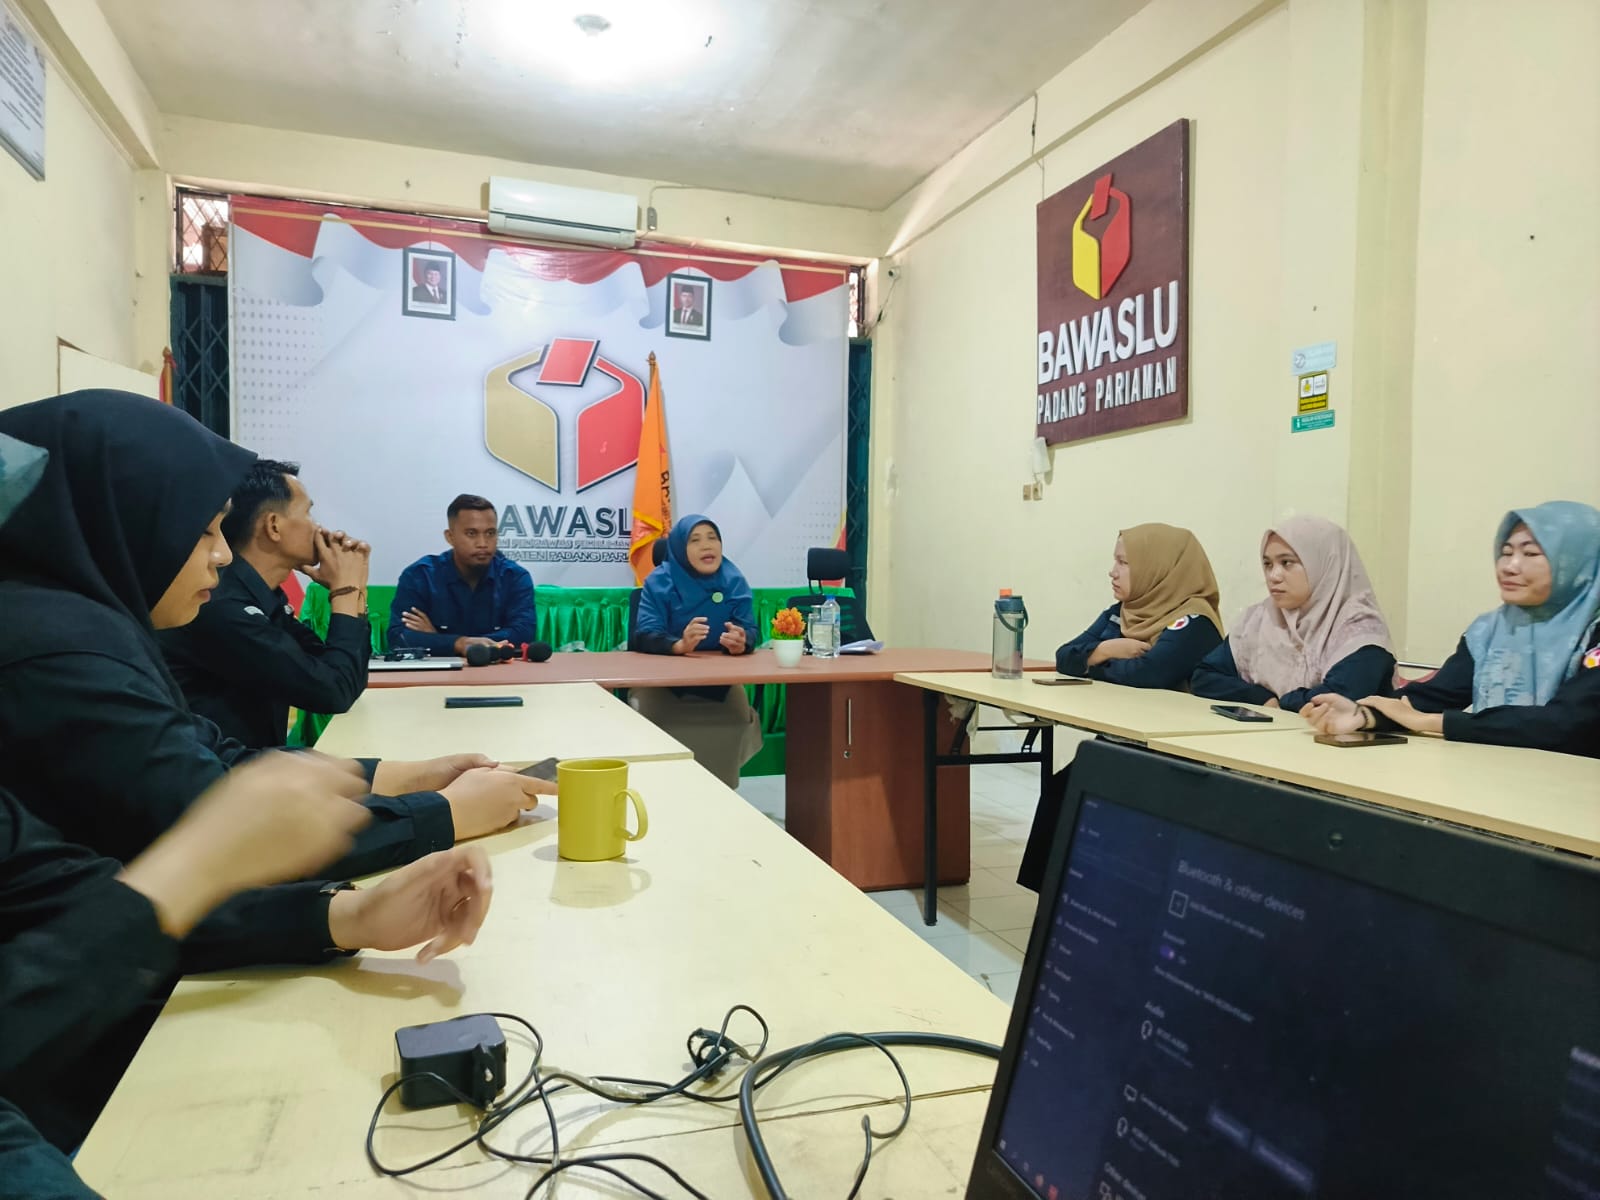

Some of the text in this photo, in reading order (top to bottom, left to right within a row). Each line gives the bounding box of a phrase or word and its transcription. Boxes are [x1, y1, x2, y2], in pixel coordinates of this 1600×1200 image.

[1037, 280, 1179, 385] BAWASLU
[1036, 356, 1177, 425] PADANG PARIAMAN
[497, 504, 632, 539] AWASL
